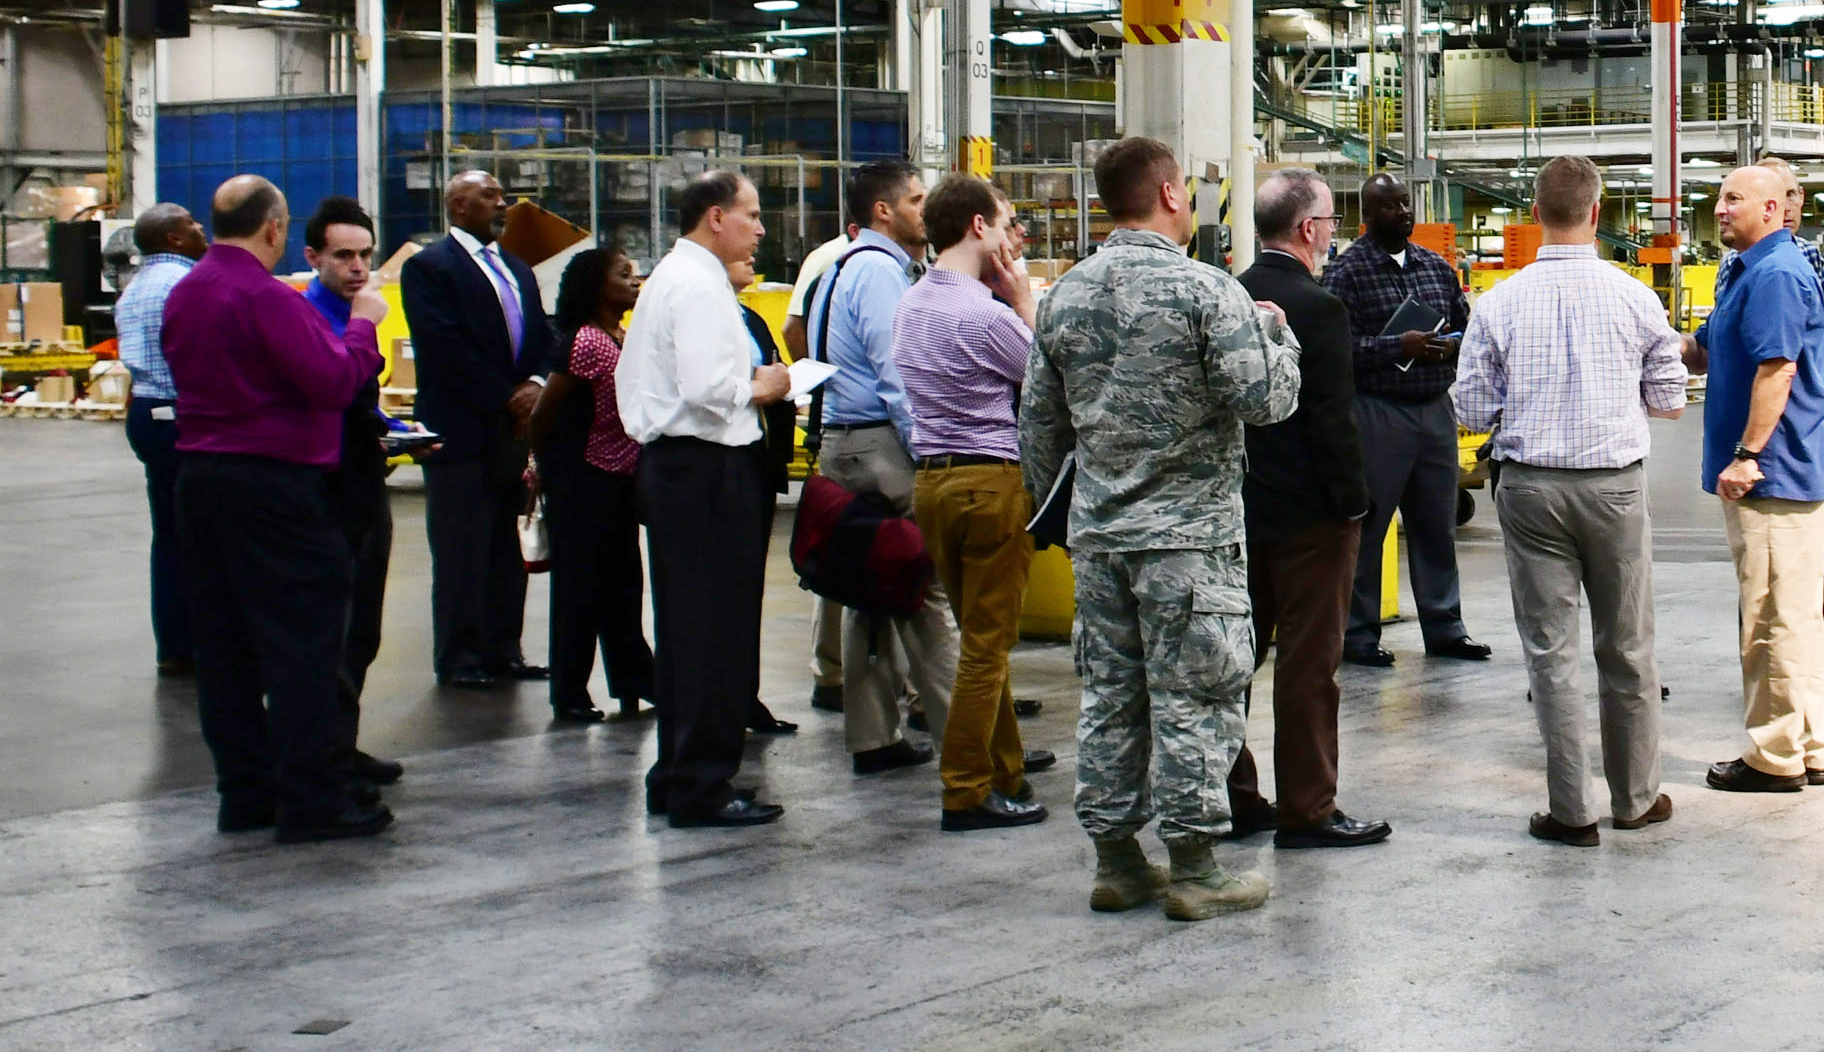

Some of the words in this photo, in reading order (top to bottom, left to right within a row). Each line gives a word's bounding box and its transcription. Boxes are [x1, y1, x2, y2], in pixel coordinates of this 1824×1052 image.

[976, 40, 985, 56] Q
[972, 62, 988, 78] 03
[139, 87, 148, 99] P
[135, 105, 151, 118] 03
